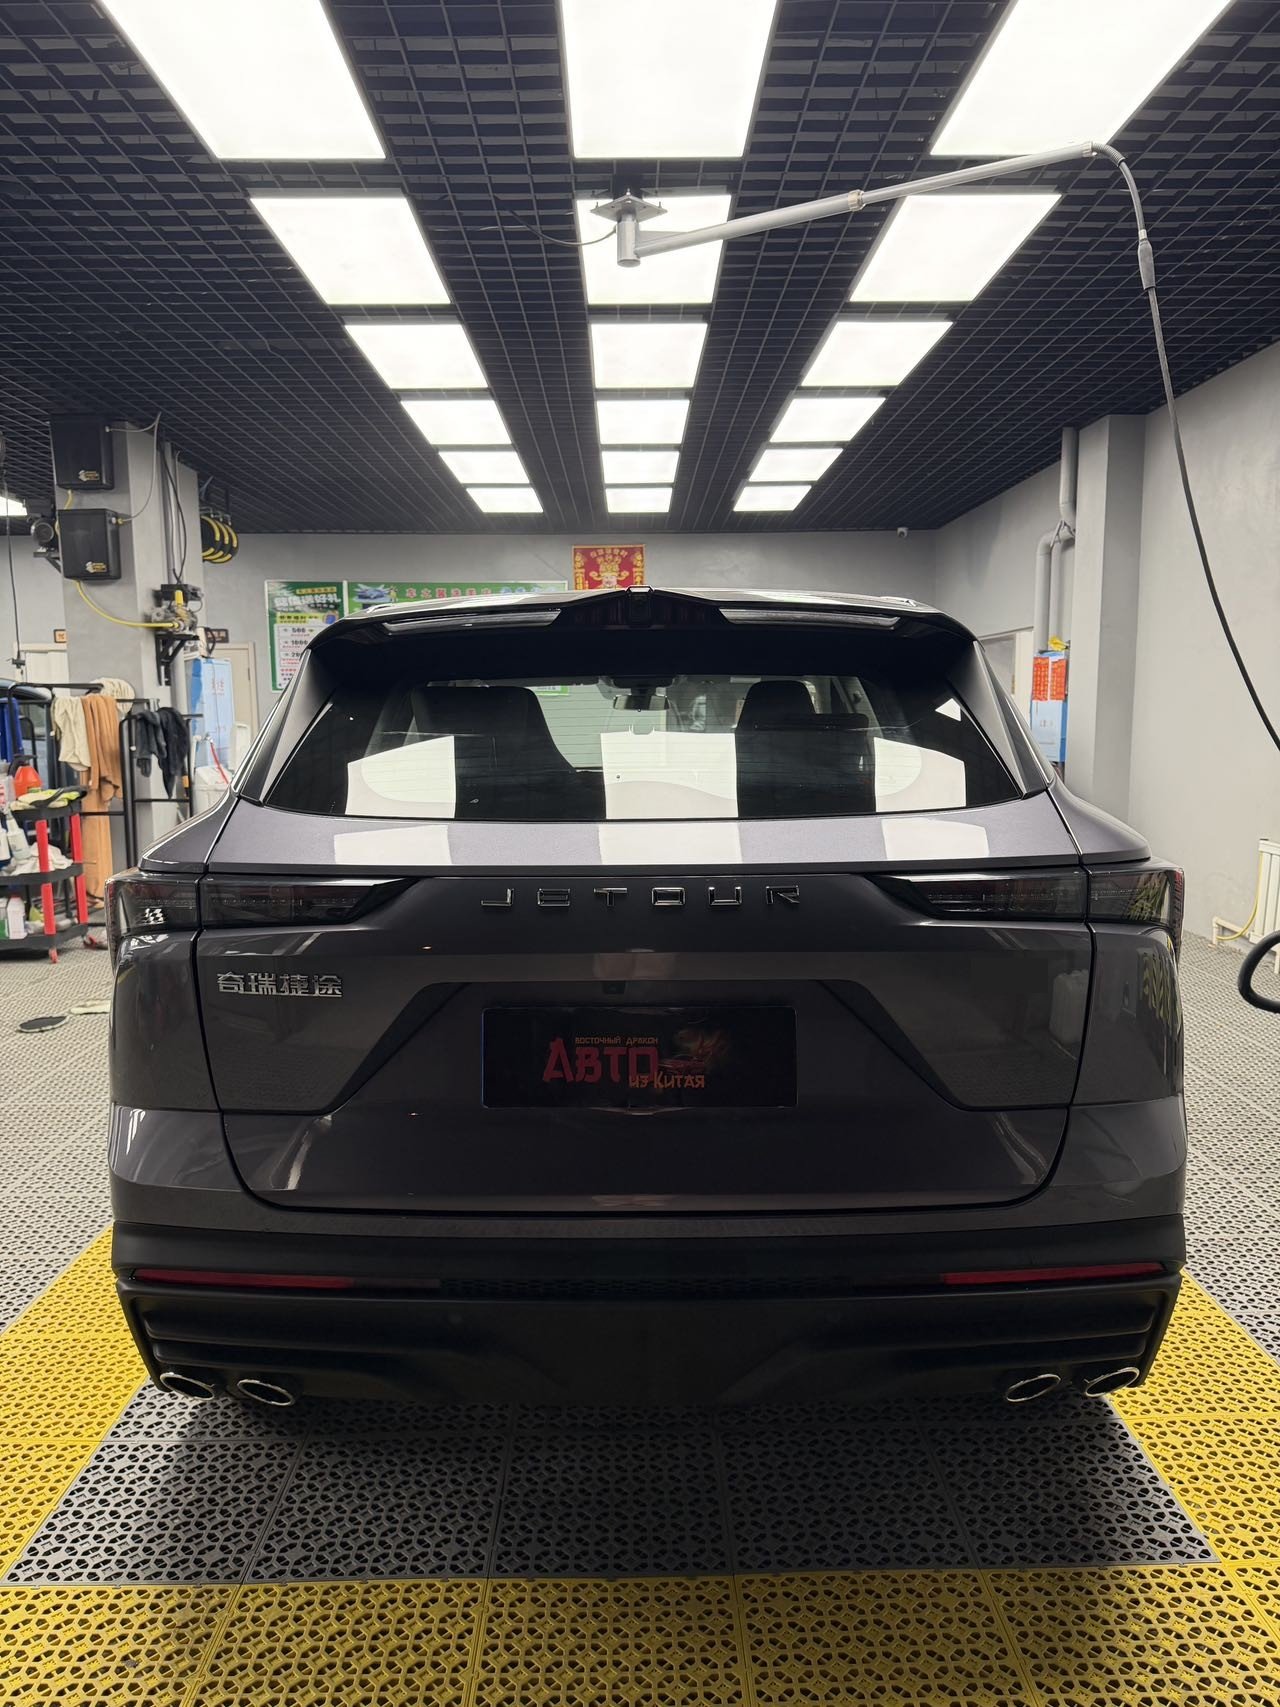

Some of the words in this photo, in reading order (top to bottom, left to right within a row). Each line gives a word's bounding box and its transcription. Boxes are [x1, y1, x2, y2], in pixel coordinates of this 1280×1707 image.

[480, 886, 802, 907] JETOUR
[216, 971, 343, 998] 奇瑞捷途
[575, 1036, 622, 1045] ВОСТОЧНЫЙ
[625, 1037, 659, 1046] ДРАКОН
